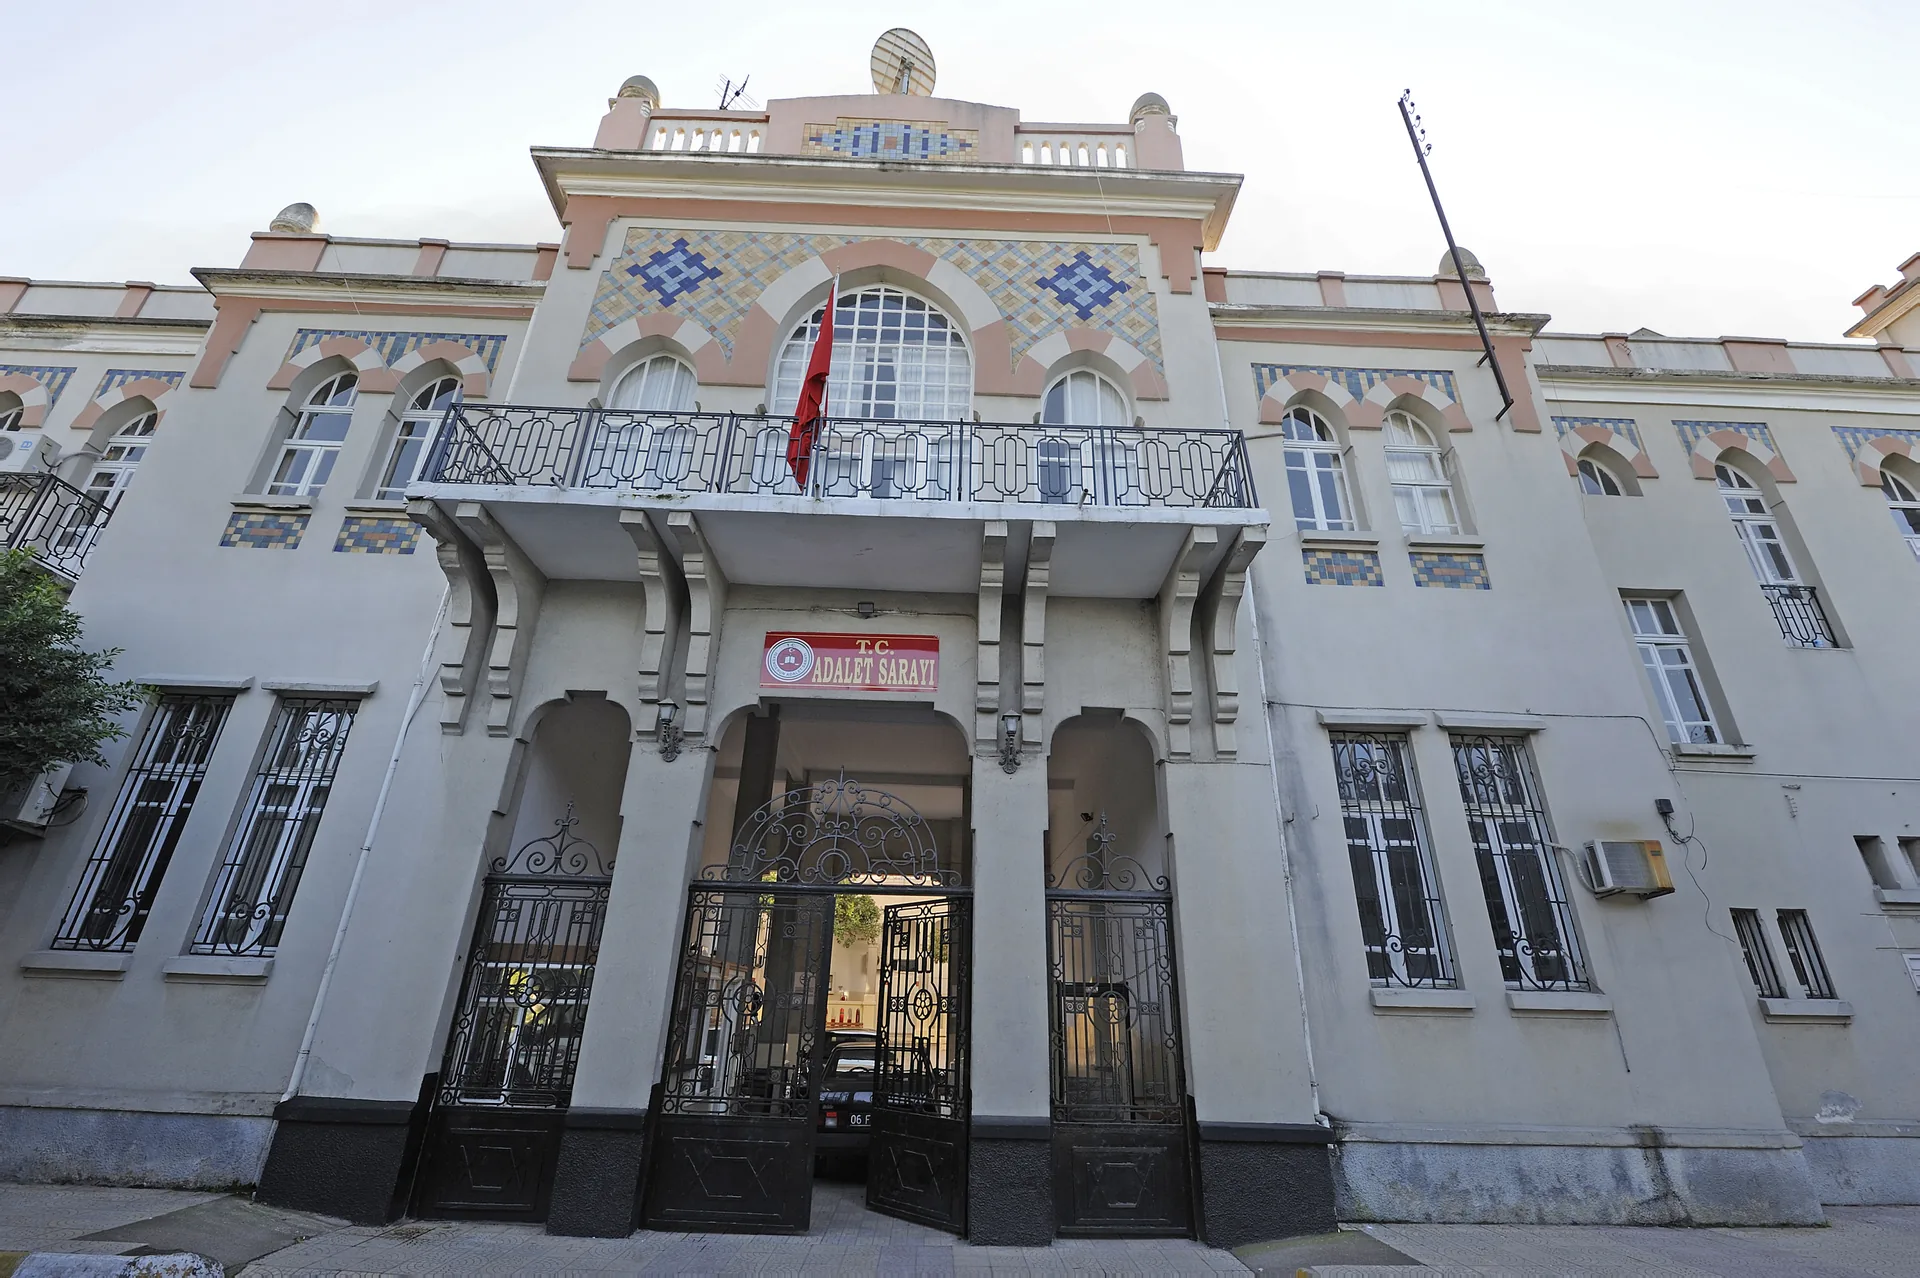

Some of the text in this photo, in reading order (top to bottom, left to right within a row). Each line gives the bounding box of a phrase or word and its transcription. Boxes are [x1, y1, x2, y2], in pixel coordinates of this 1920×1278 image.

[856, 640, 894, 655] T.C.
[811, 656, 935, 685] ADALET SARAYI
[850, 1114, 862, 1125] 06
